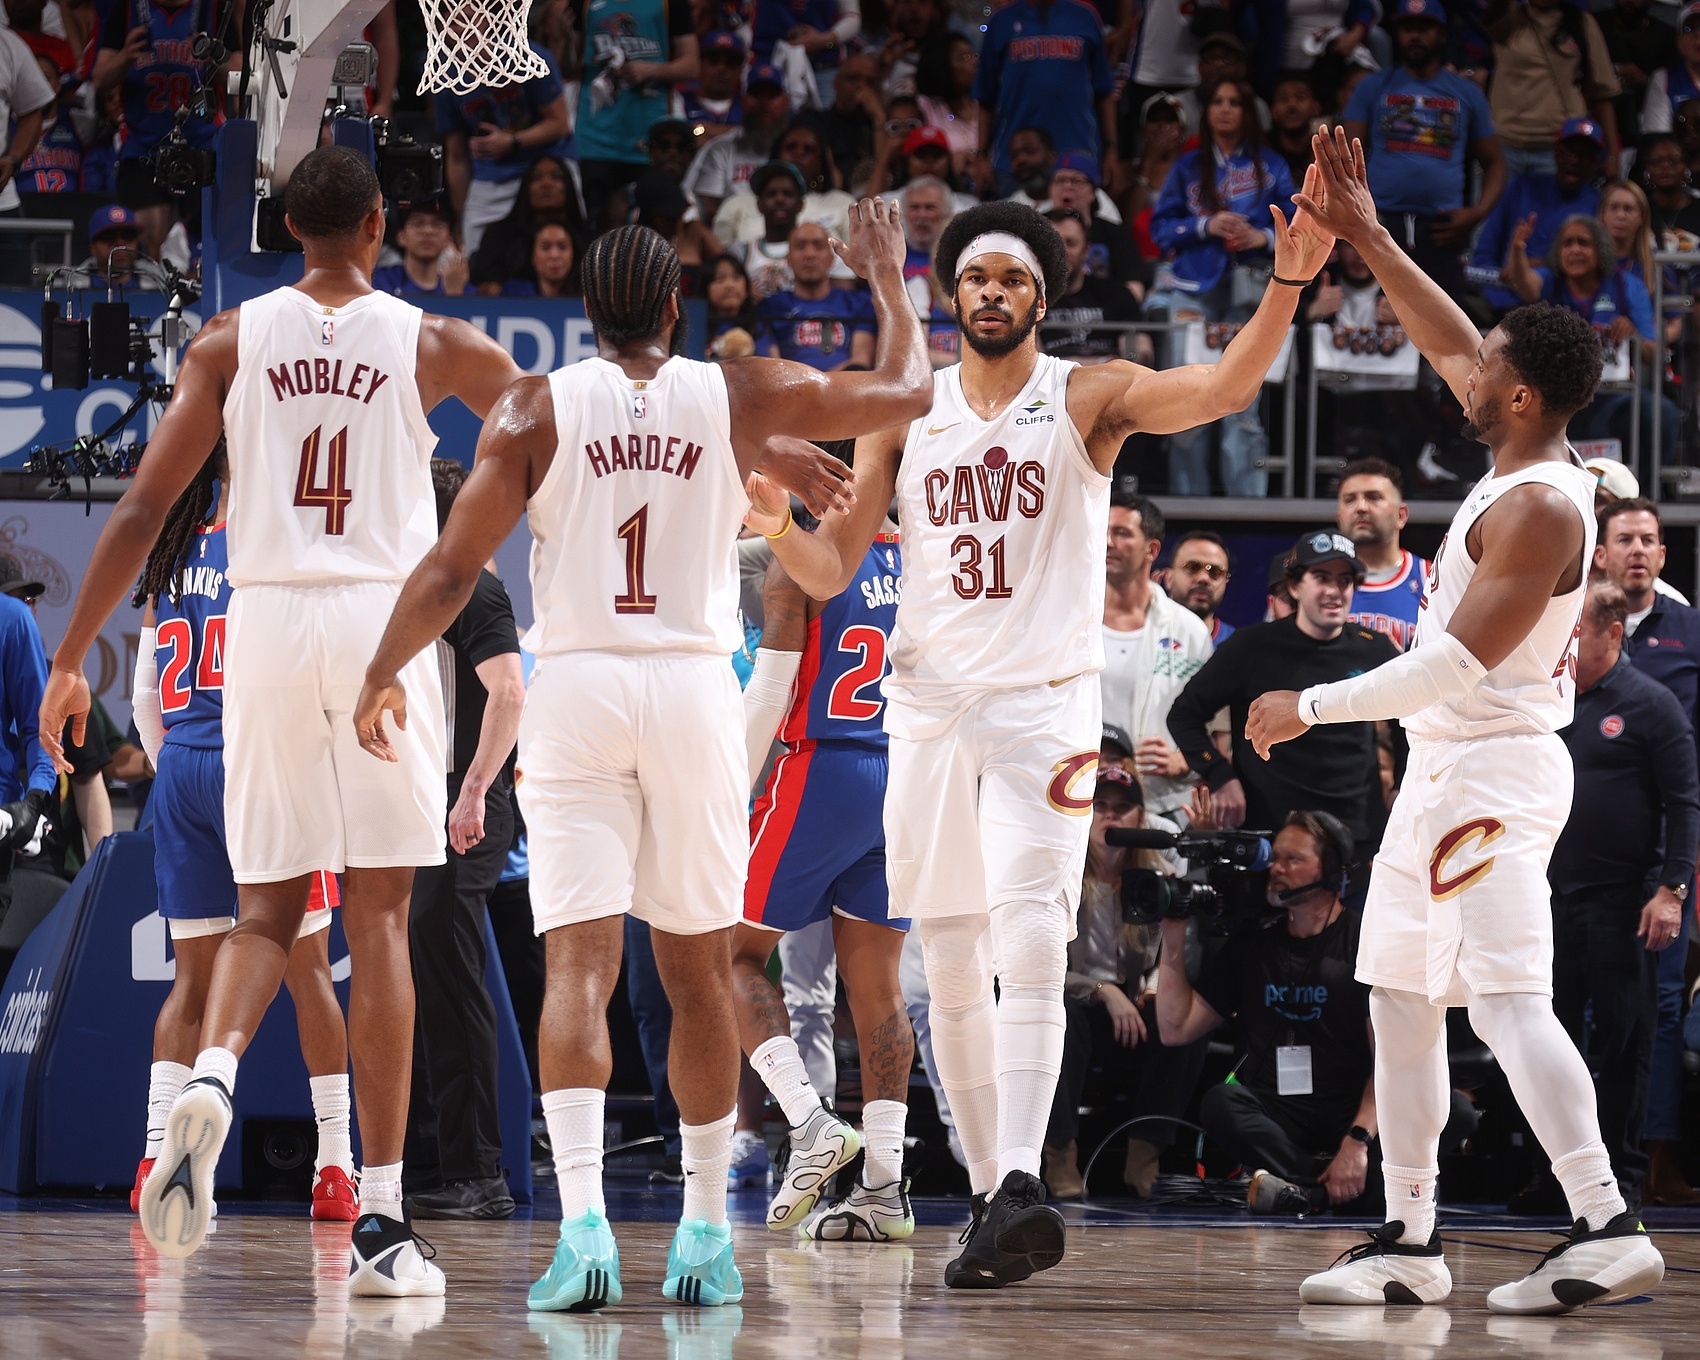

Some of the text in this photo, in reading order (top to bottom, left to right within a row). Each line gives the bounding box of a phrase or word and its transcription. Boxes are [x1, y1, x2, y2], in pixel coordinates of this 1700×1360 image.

[266, 358, 389, 405] MOBLEY
[1015, 414, 1055, 426] CLIFFS
[293, 423, 353, 535] 4
[585, 434, 704, 481] HARDEN
[924, 460, 1046, 527] CAVS
[168, 566, 224, 604] JNKINS
[615, 502, 658, 615] 1
[950, 534, 1013, 600] 31
[860, 575, 903, 610] SASS
[155, 614, 227, 714] 24
